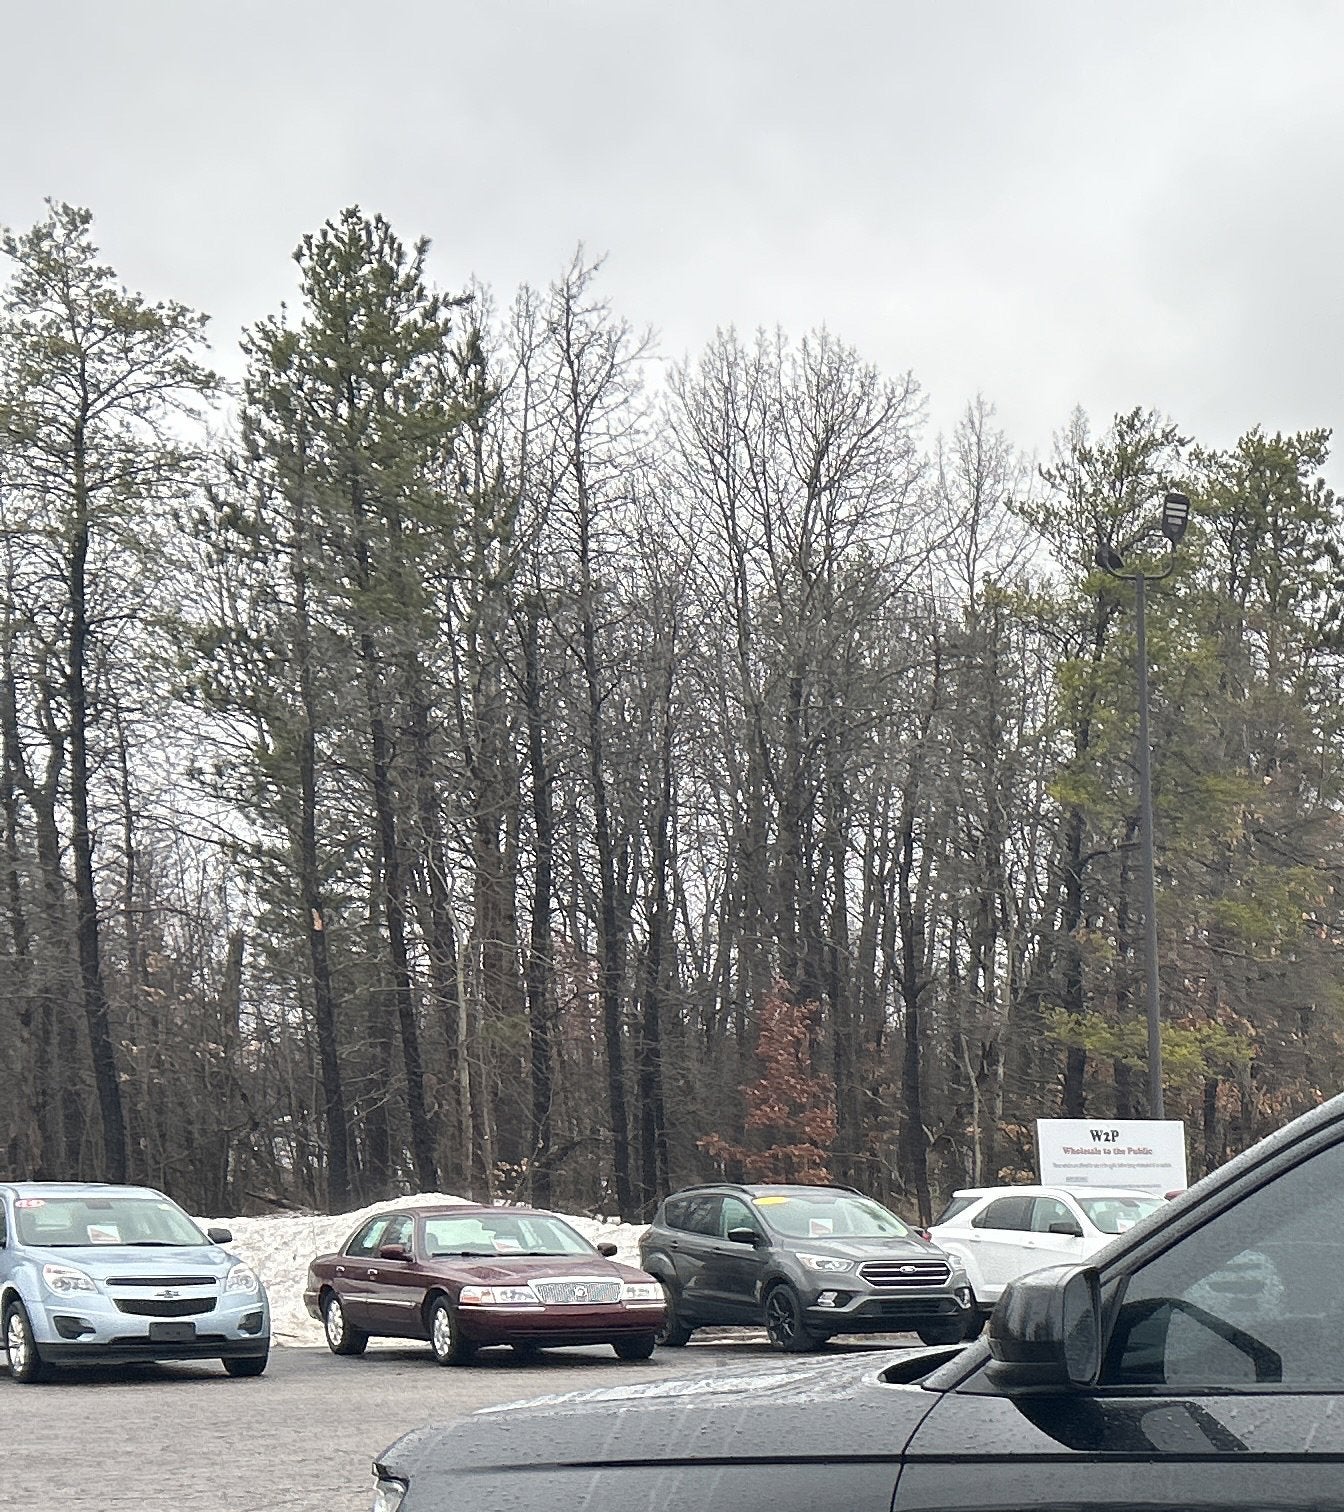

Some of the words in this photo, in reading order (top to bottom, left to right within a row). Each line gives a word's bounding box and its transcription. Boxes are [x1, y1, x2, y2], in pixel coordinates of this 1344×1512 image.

[1089, 1129, 1119, 1142] W2P
[1062, 1147, 1101, 1155] Wholesale
[1113, 1147, 1126, 1155] the
[1127, 1147, 1153, 1155] Public
